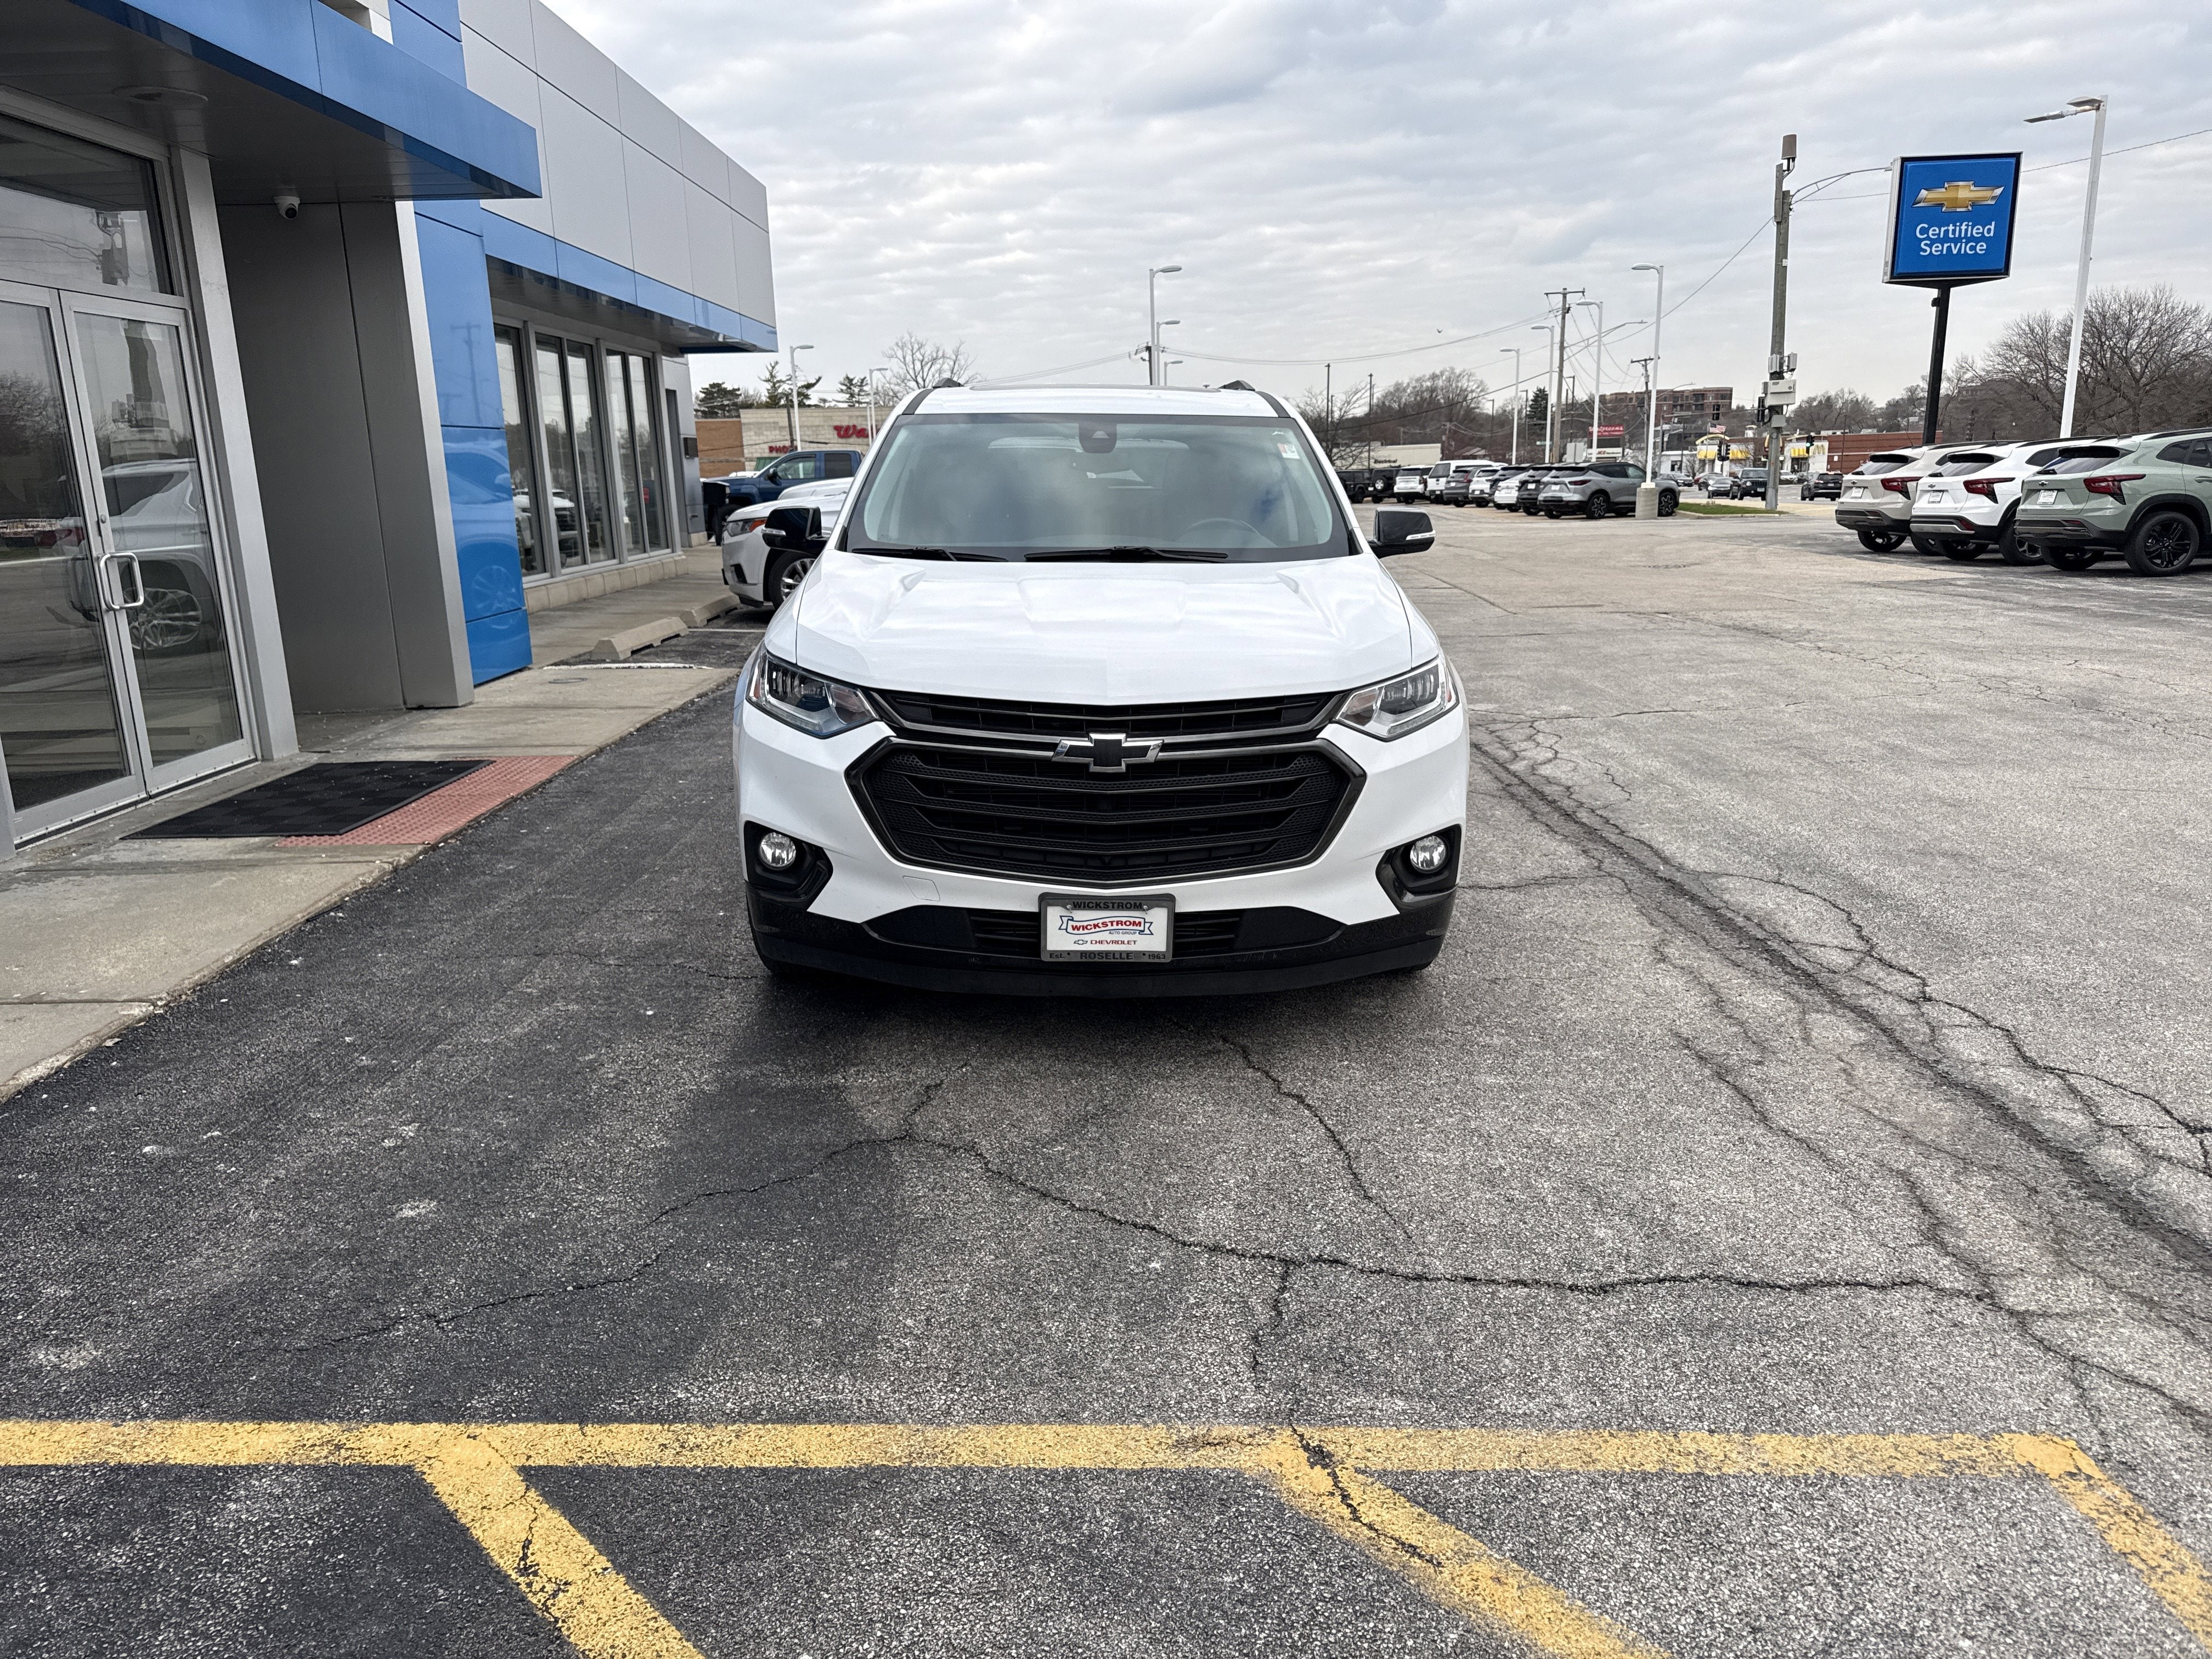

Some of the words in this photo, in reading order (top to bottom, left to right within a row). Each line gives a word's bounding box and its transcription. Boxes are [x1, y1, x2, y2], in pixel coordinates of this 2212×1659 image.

[1916, 221, 1995, 239] Certified
[1920, 239, 1987, 255] Service
[1073, 901, 1142, 910] WICKSTROM
[1071, 920, 1142, 932] WICKSTROM
